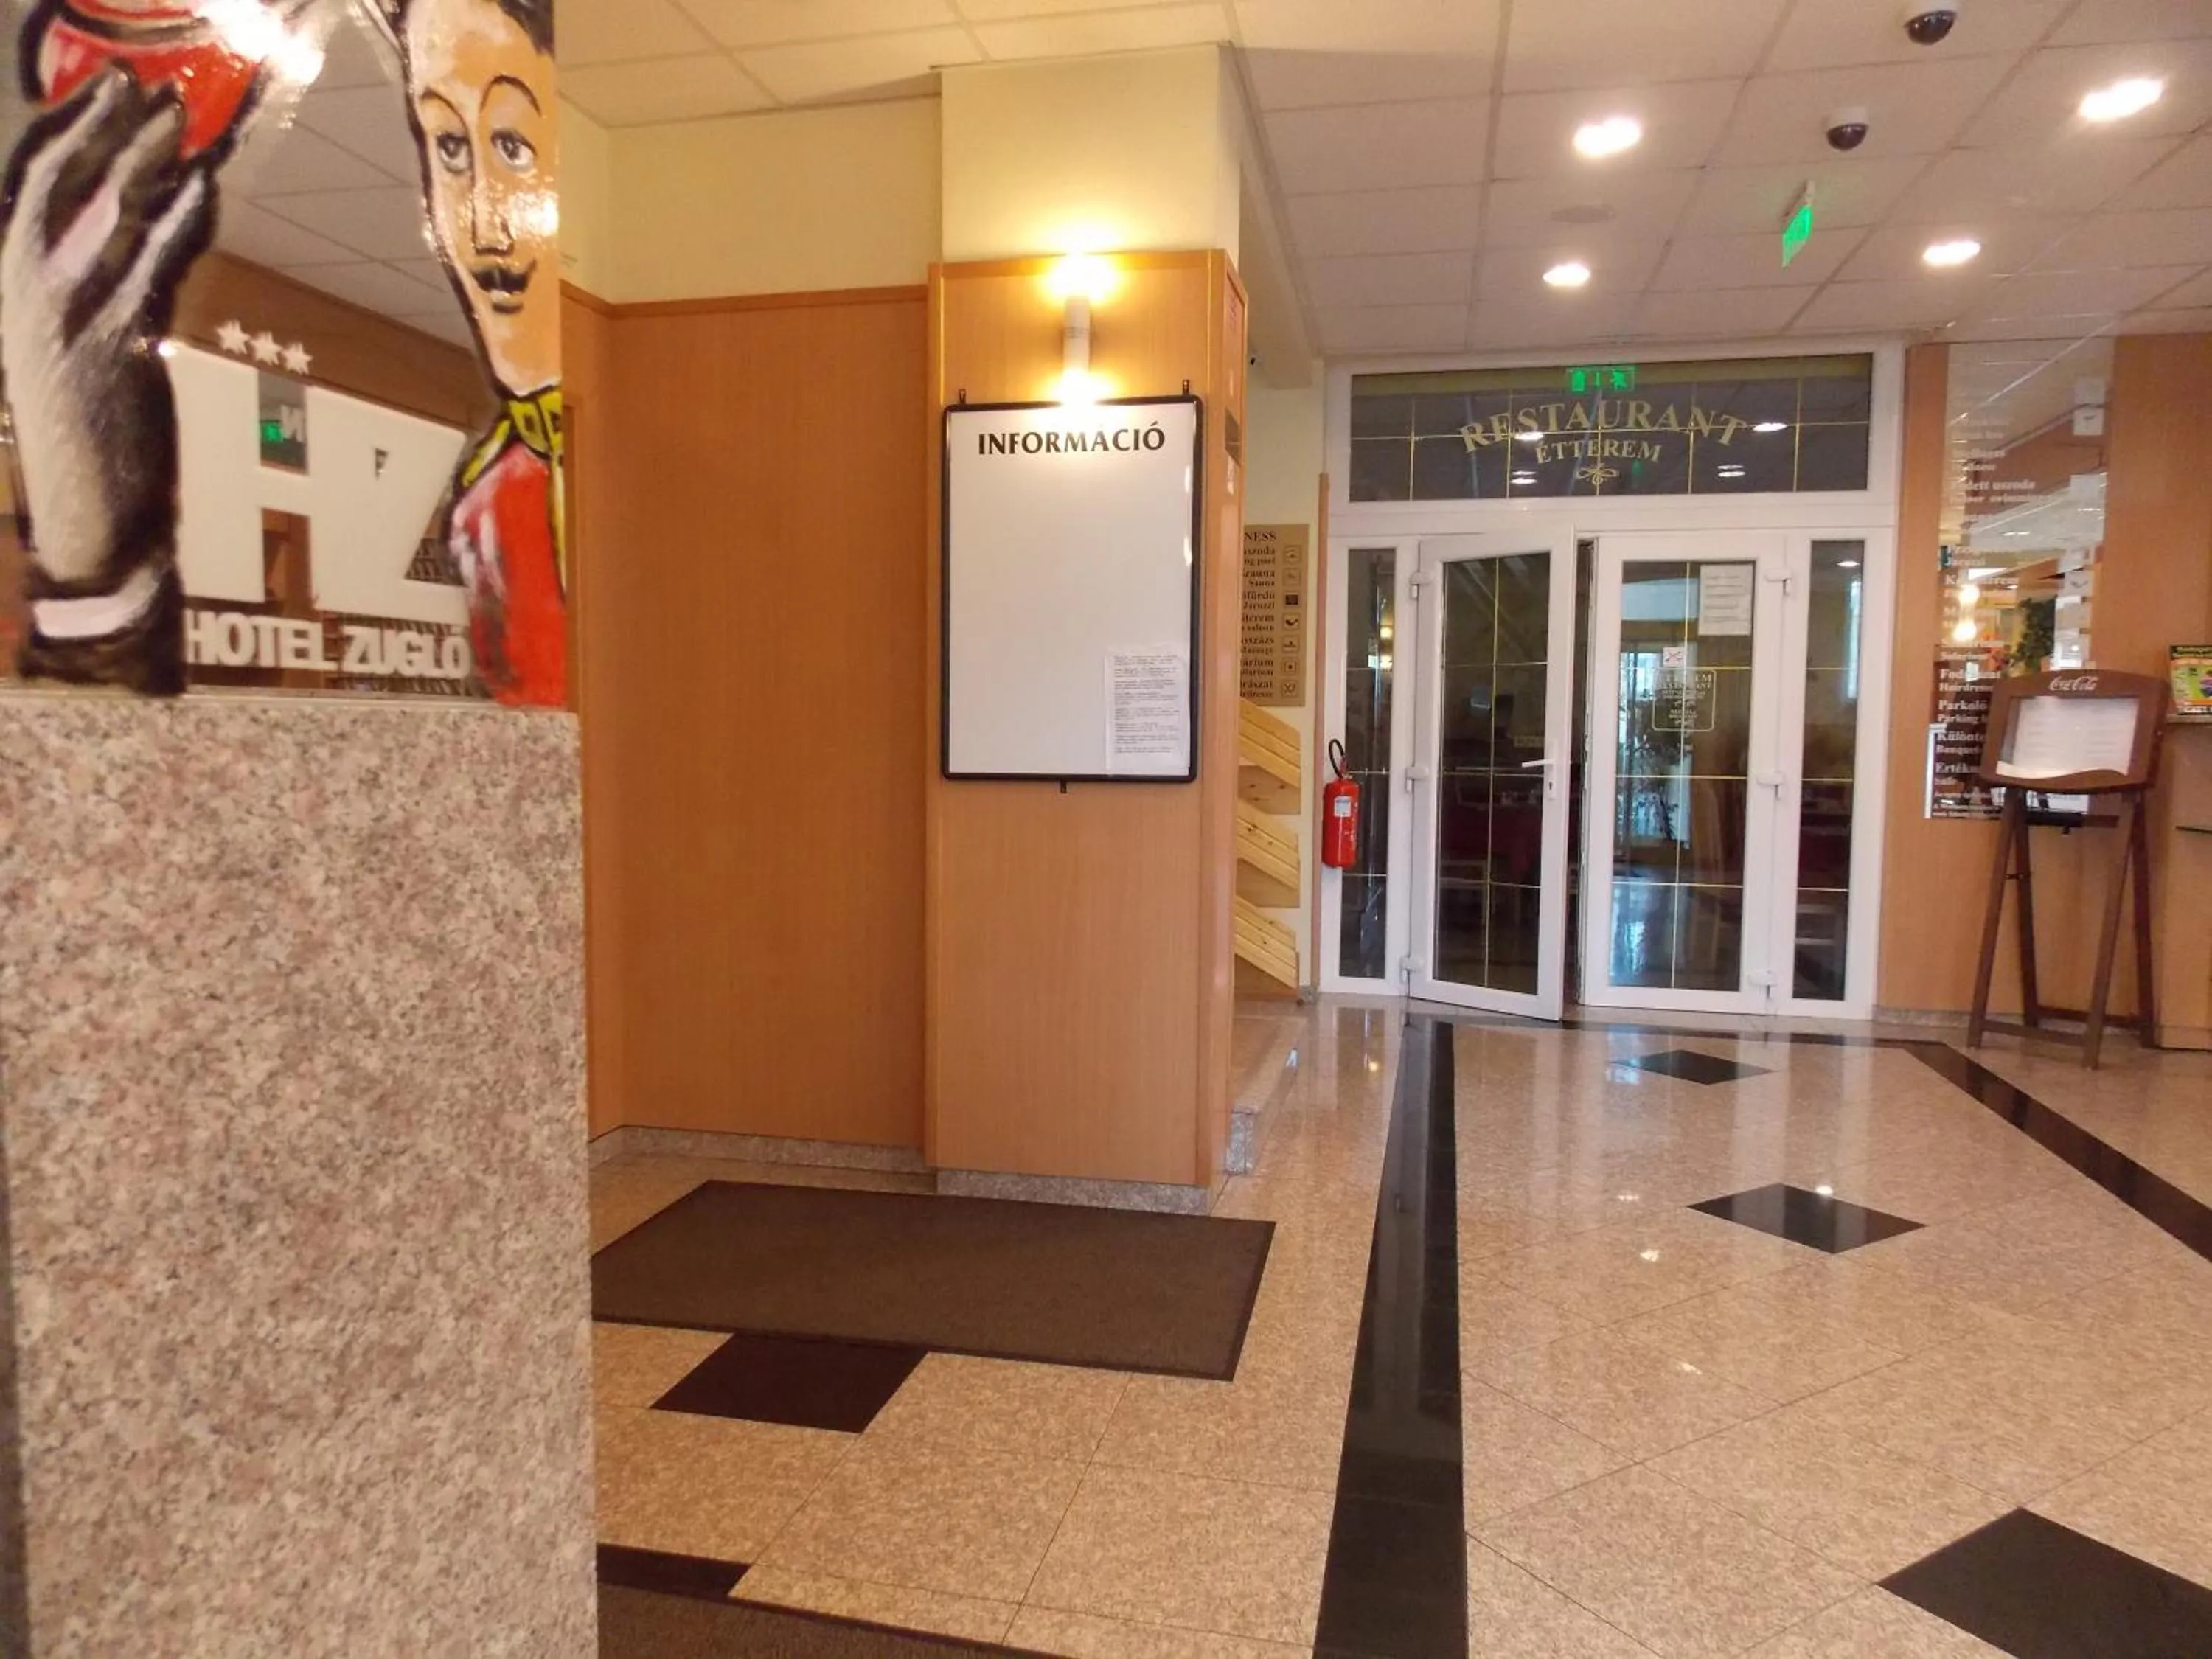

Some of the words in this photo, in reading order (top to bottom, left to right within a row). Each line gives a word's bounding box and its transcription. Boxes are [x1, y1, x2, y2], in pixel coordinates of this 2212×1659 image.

[978, 421, 1166, 455] INFORMACIÓ
[1457, 400, 1747, 453] RESTAURANT
[1536, 438, 1662, 464] ÉTTEREM
[184, 609, 338, 671] HOTEL
